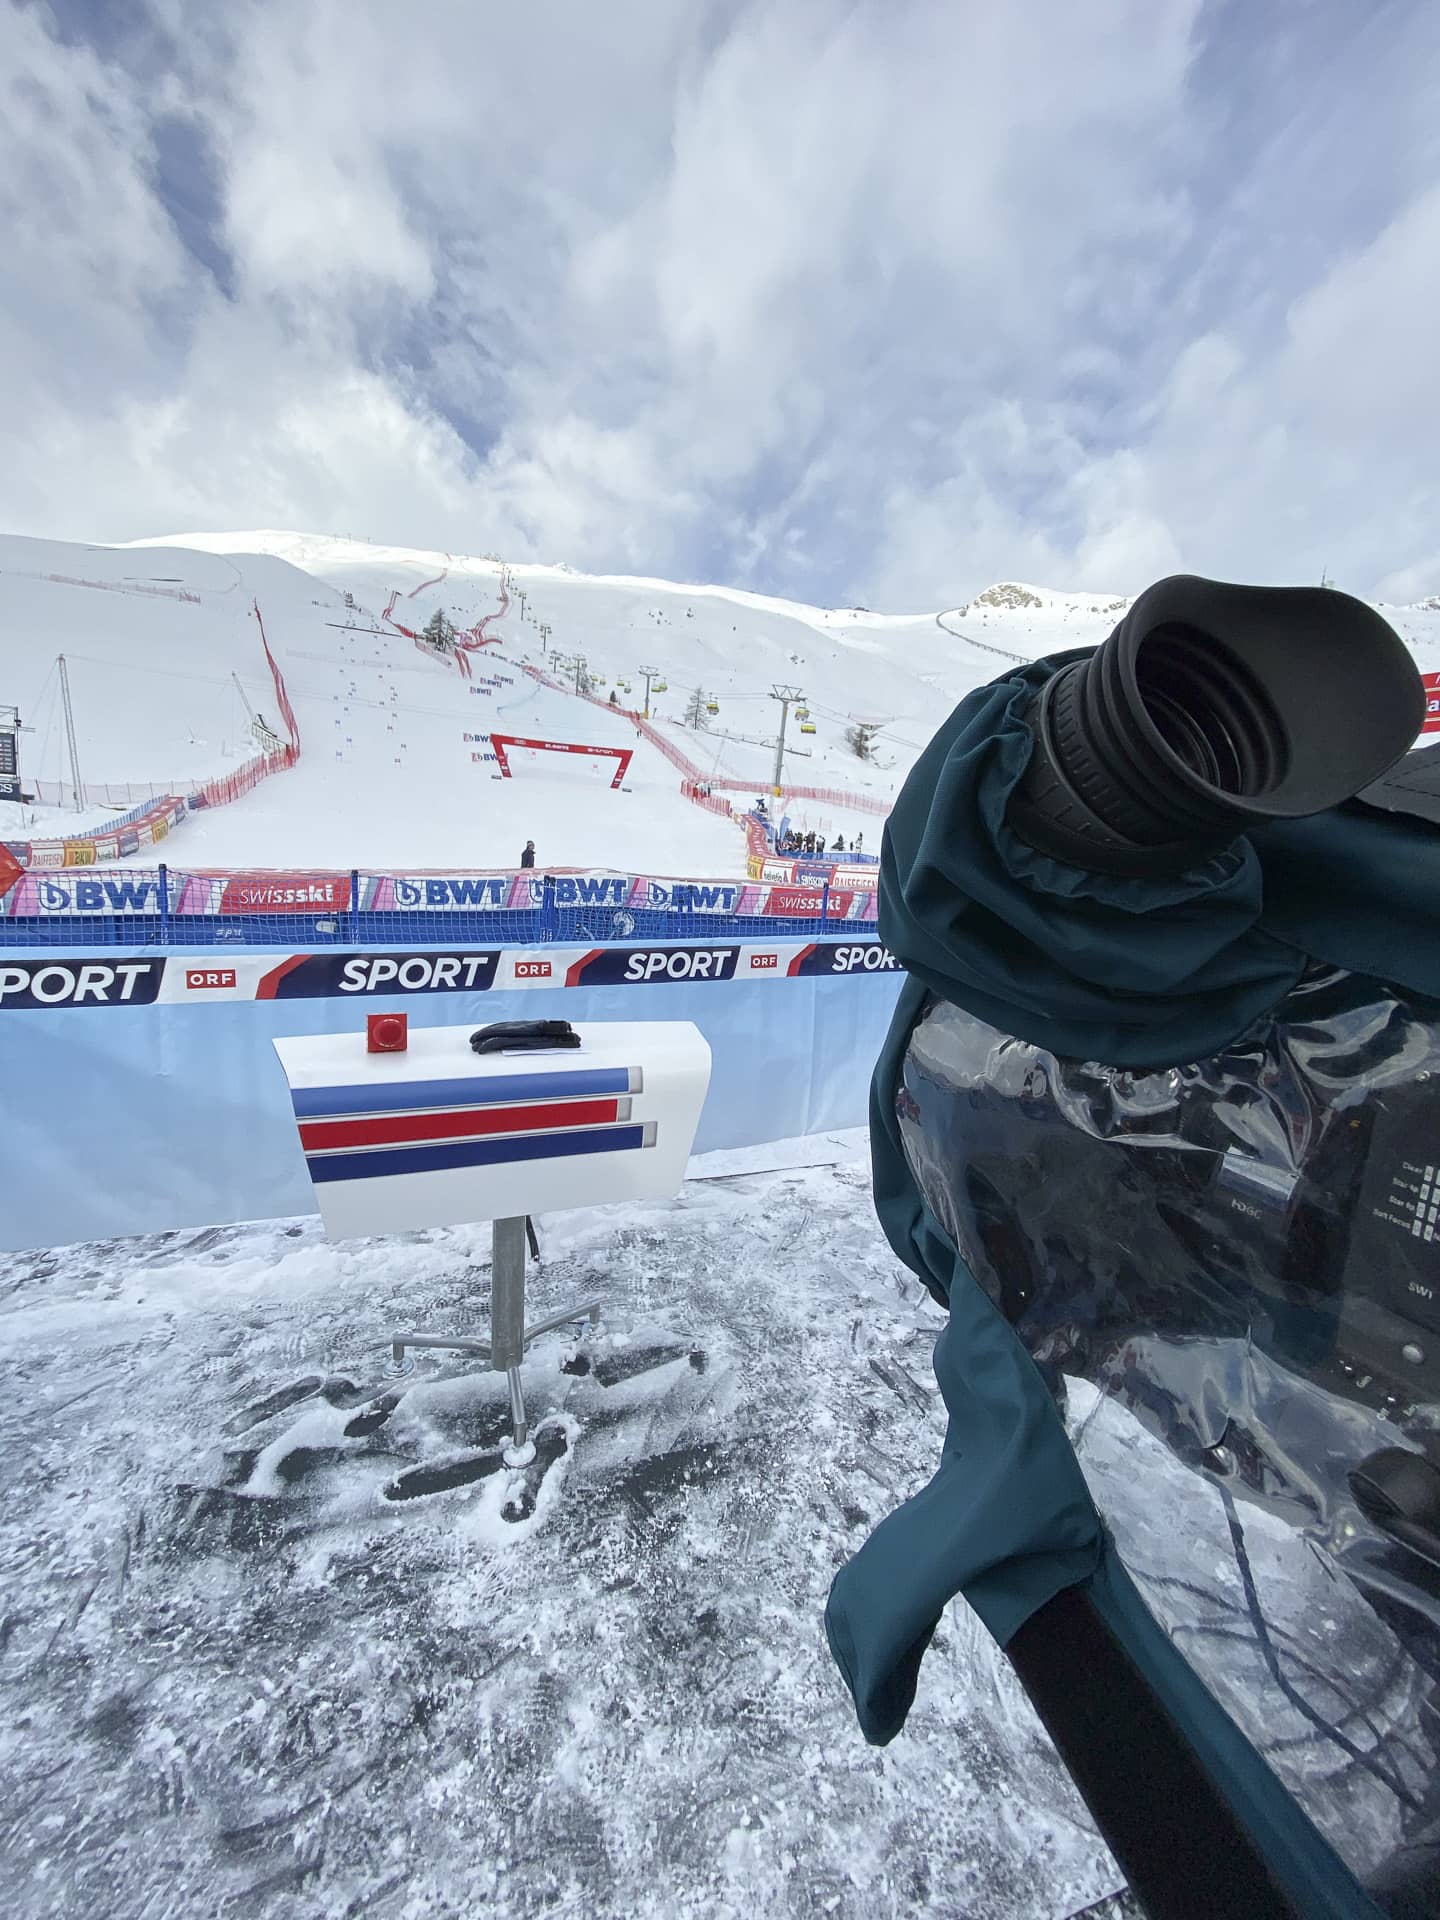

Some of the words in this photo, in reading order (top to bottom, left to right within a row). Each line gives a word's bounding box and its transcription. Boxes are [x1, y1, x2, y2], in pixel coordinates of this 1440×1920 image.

[76, 881, 174, 910] BWT
[240, 884, 334, 904] swissski
[425, 879, 505, 906] BWT
[556, 878, 627, 903] BWT
[190, 972, 233, 986] ORF
[338, 957, 489, 992] SPORT
[517, 964, 550, 976] ORF
[624, 950, 732, 980] SPORT
[752, 956, 776, 968] ORF
[832, 946, 902, 971] SPOR
